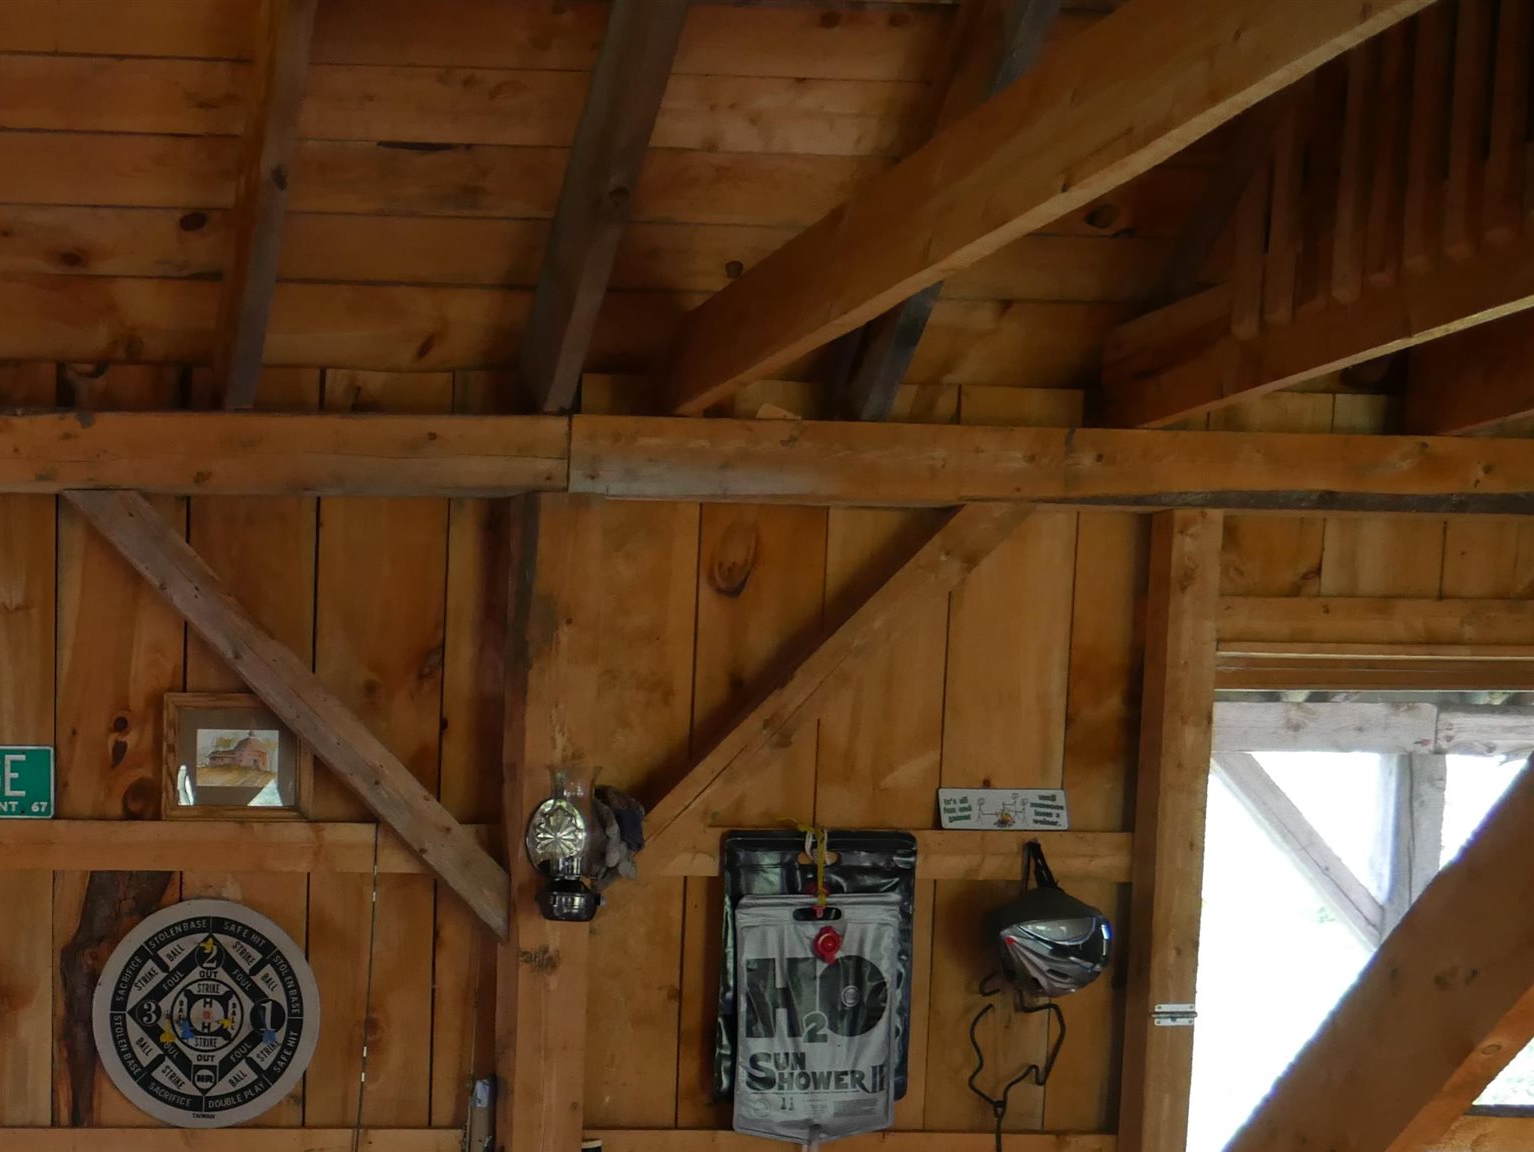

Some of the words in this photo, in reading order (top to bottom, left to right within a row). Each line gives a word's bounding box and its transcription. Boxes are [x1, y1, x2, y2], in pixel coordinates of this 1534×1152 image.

[31, 801, 48, 813] 67
[148, 924, 183, 950] STOLEN
[182, 919, 208, 932] BASE
[222, 921, 247, 938] SAFE
[249, 933, 267, 948] HIT
[166, 944, 186, 962] BALL
[200, 942, 219, 968] 2
[231, 941, 257, 967] STRIKE
[115, 954, 144, 1002] SACRIFICE
[133, 966, 159, 992] STRIKE
[162, 970, 185, 991] FOUL
[199, 970, 219, 979] OUT
[231, 968, 253, 991] FOUL
[260, 972, 279, 992] BALL
[272, 954, 296, 989] STOLEN
[287, 989, 301, 1015] BASE
[196, 983, 220, 994] STRIKE
[745, 954, 889, 1044] H2O
[142, 1000, 157, 1025] 3
[203, 998, 213, 1009] H
[201, 1022, 211, 1033] H
[113, 1014, 127, 1052] STOLEN
[123, 1052, 142, 1076] BASE
[135, 1036, 154, 1057] BALL
[194, 1037, 218, 1048] STRIKE
[230, 1041, 253, 1063] FOUL
[256, 1040, 283, 1063] STRIKE
[272, 1049, 292, 1073] SAFE
[286, 1030, 299, 1050] HIT
[197, 1054, 216, 1062] OUT
[161, 1065, 186, 1090] STRIKE
[196, 1074, 214, 1083] HR
[228, 1069, 248, 1088] BALL
[745, 1062, 871, 1093] SHOWER
[148, 1081, 193, 1107] SACRIFICE
[208, 1093, 243, 1109] DOUBLE
[243, 1080, 265, 1100] PLAY
